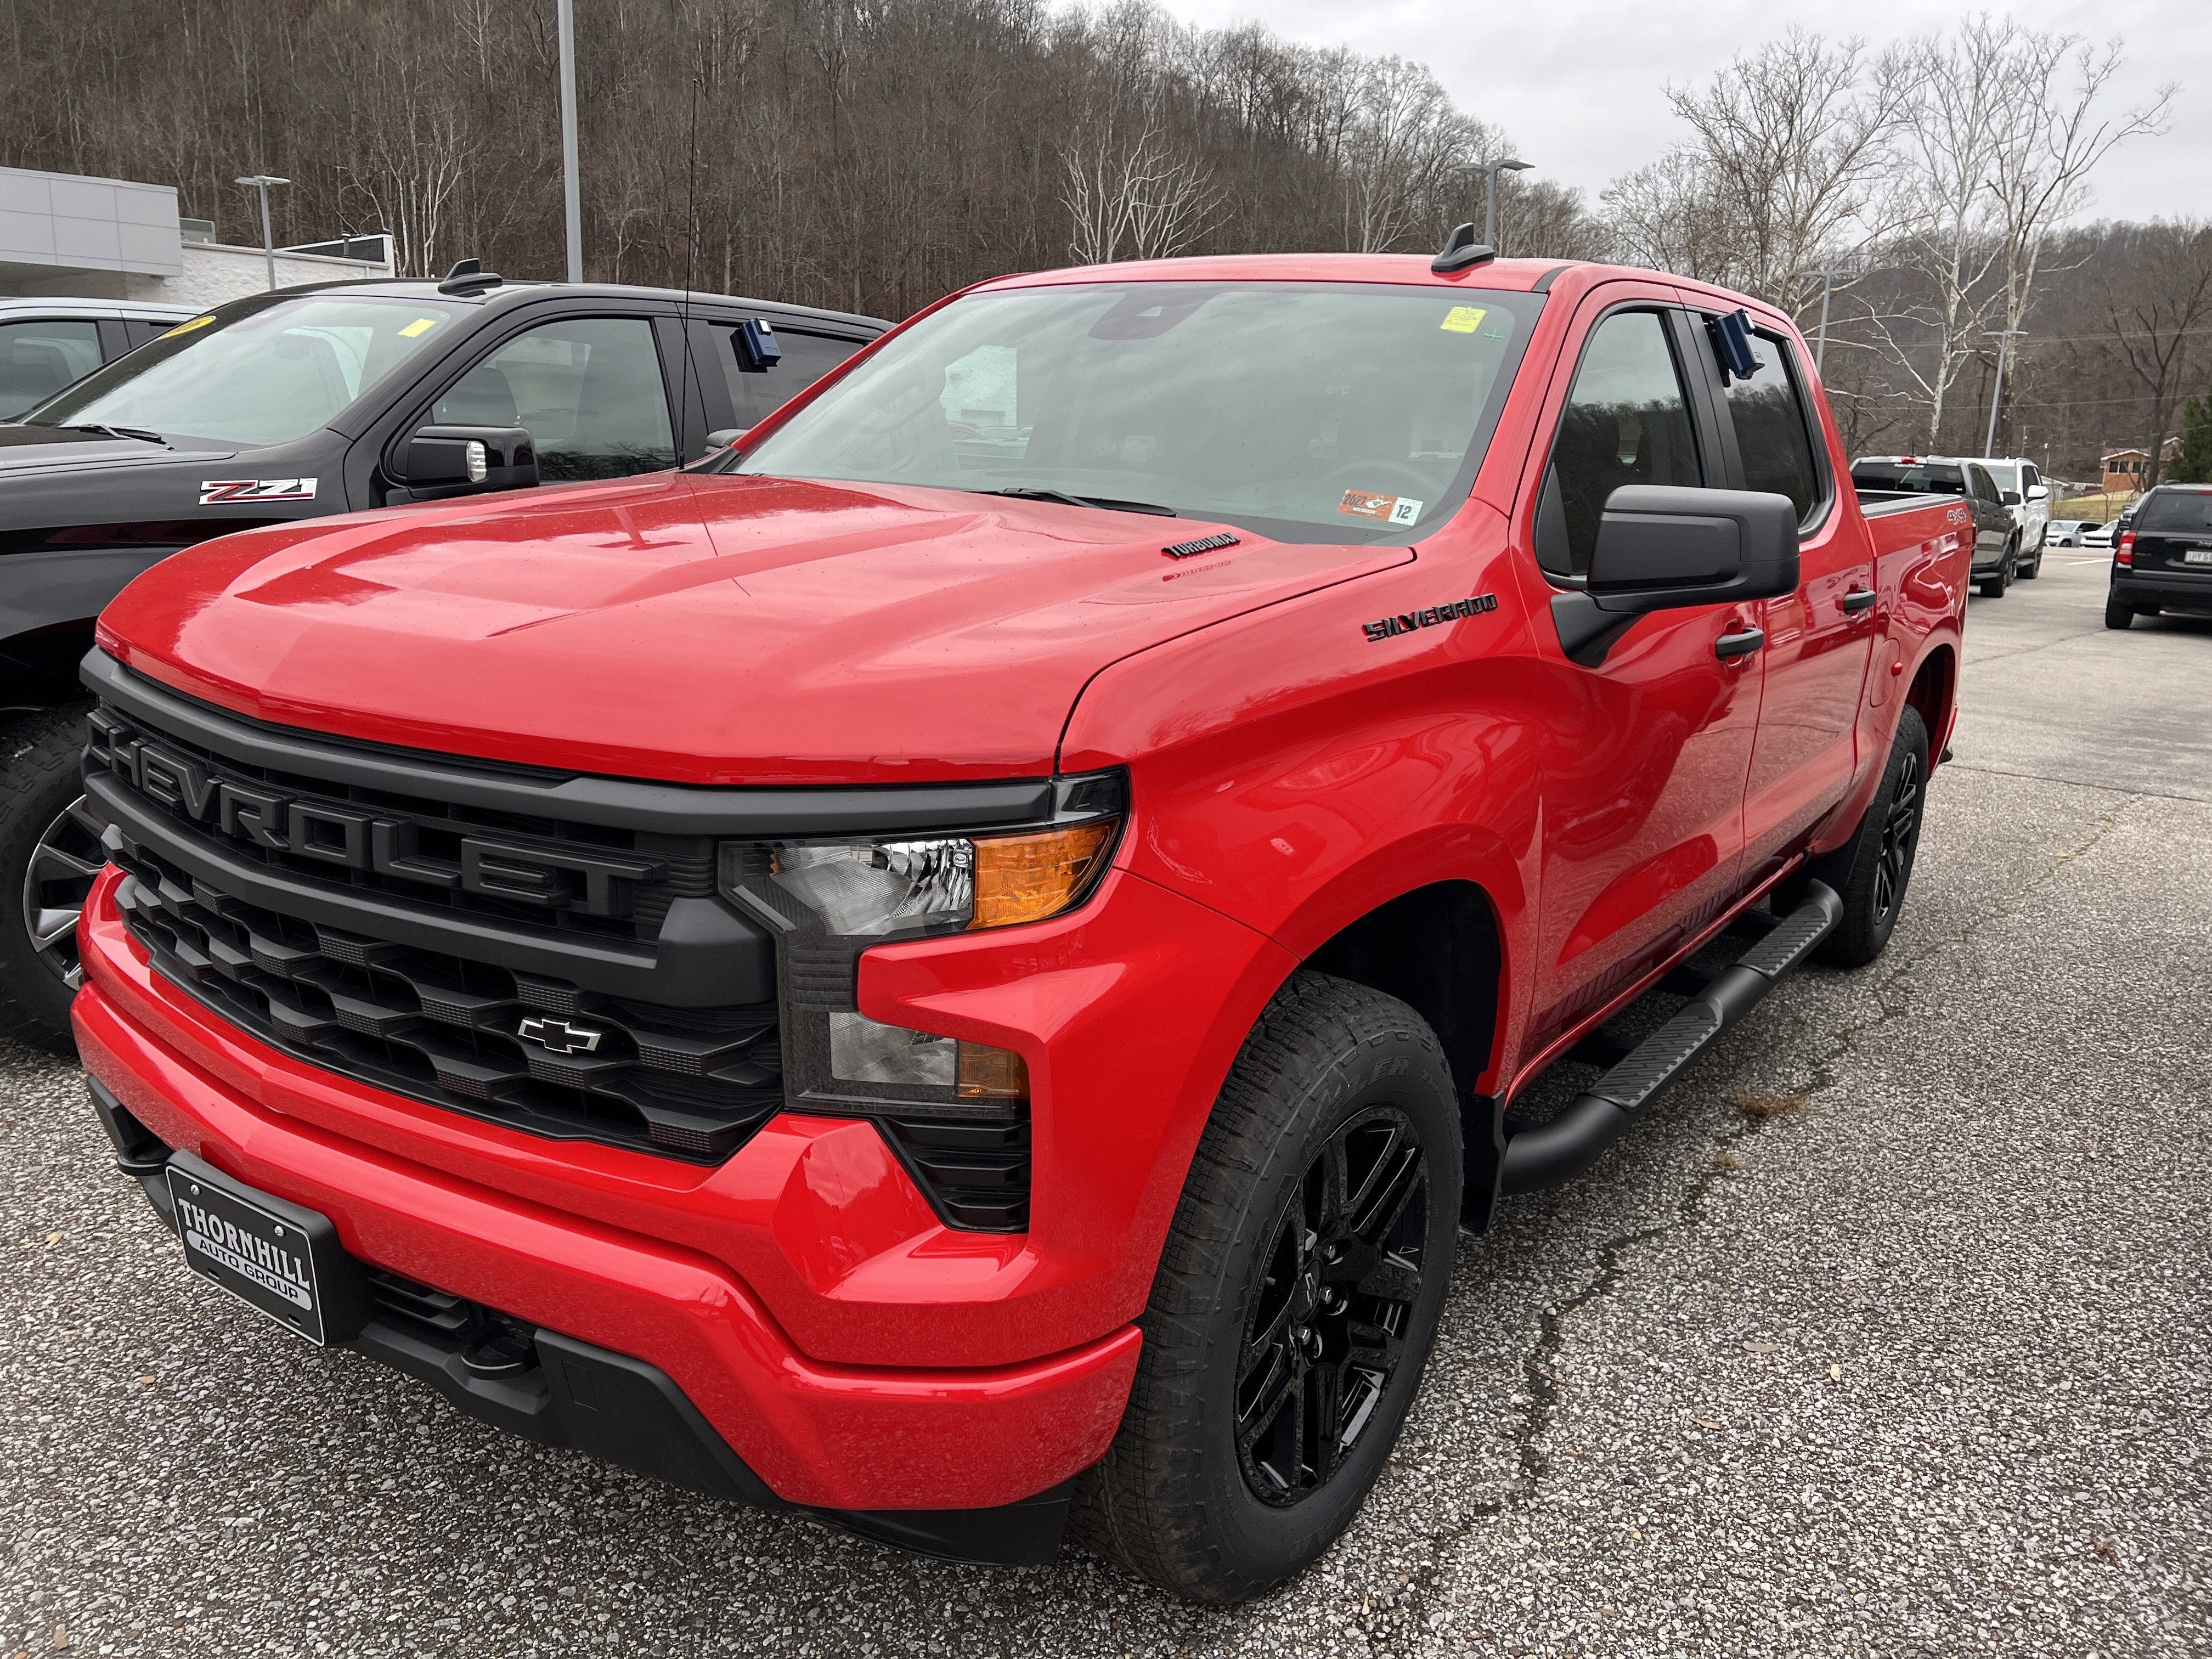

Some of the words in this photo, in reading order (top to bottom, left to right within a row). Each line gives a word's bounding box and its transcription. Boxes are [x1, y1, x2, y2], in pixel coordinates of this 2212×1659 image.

[1343, 493, 1368, 506] 2027
[1396, 504, 1412, 519] 12
[1161, 532, 1241, 558] TURBOMAX
[1362, 592, 1498, 642] SILVERADO
[87, 707, 669, 917] CHEVROLET
[178, 1198, 311, 1290] THORNHILL
[199, 1239, 240, 1269] AUTO
[244, 1263, 298, 1299] GROUP
